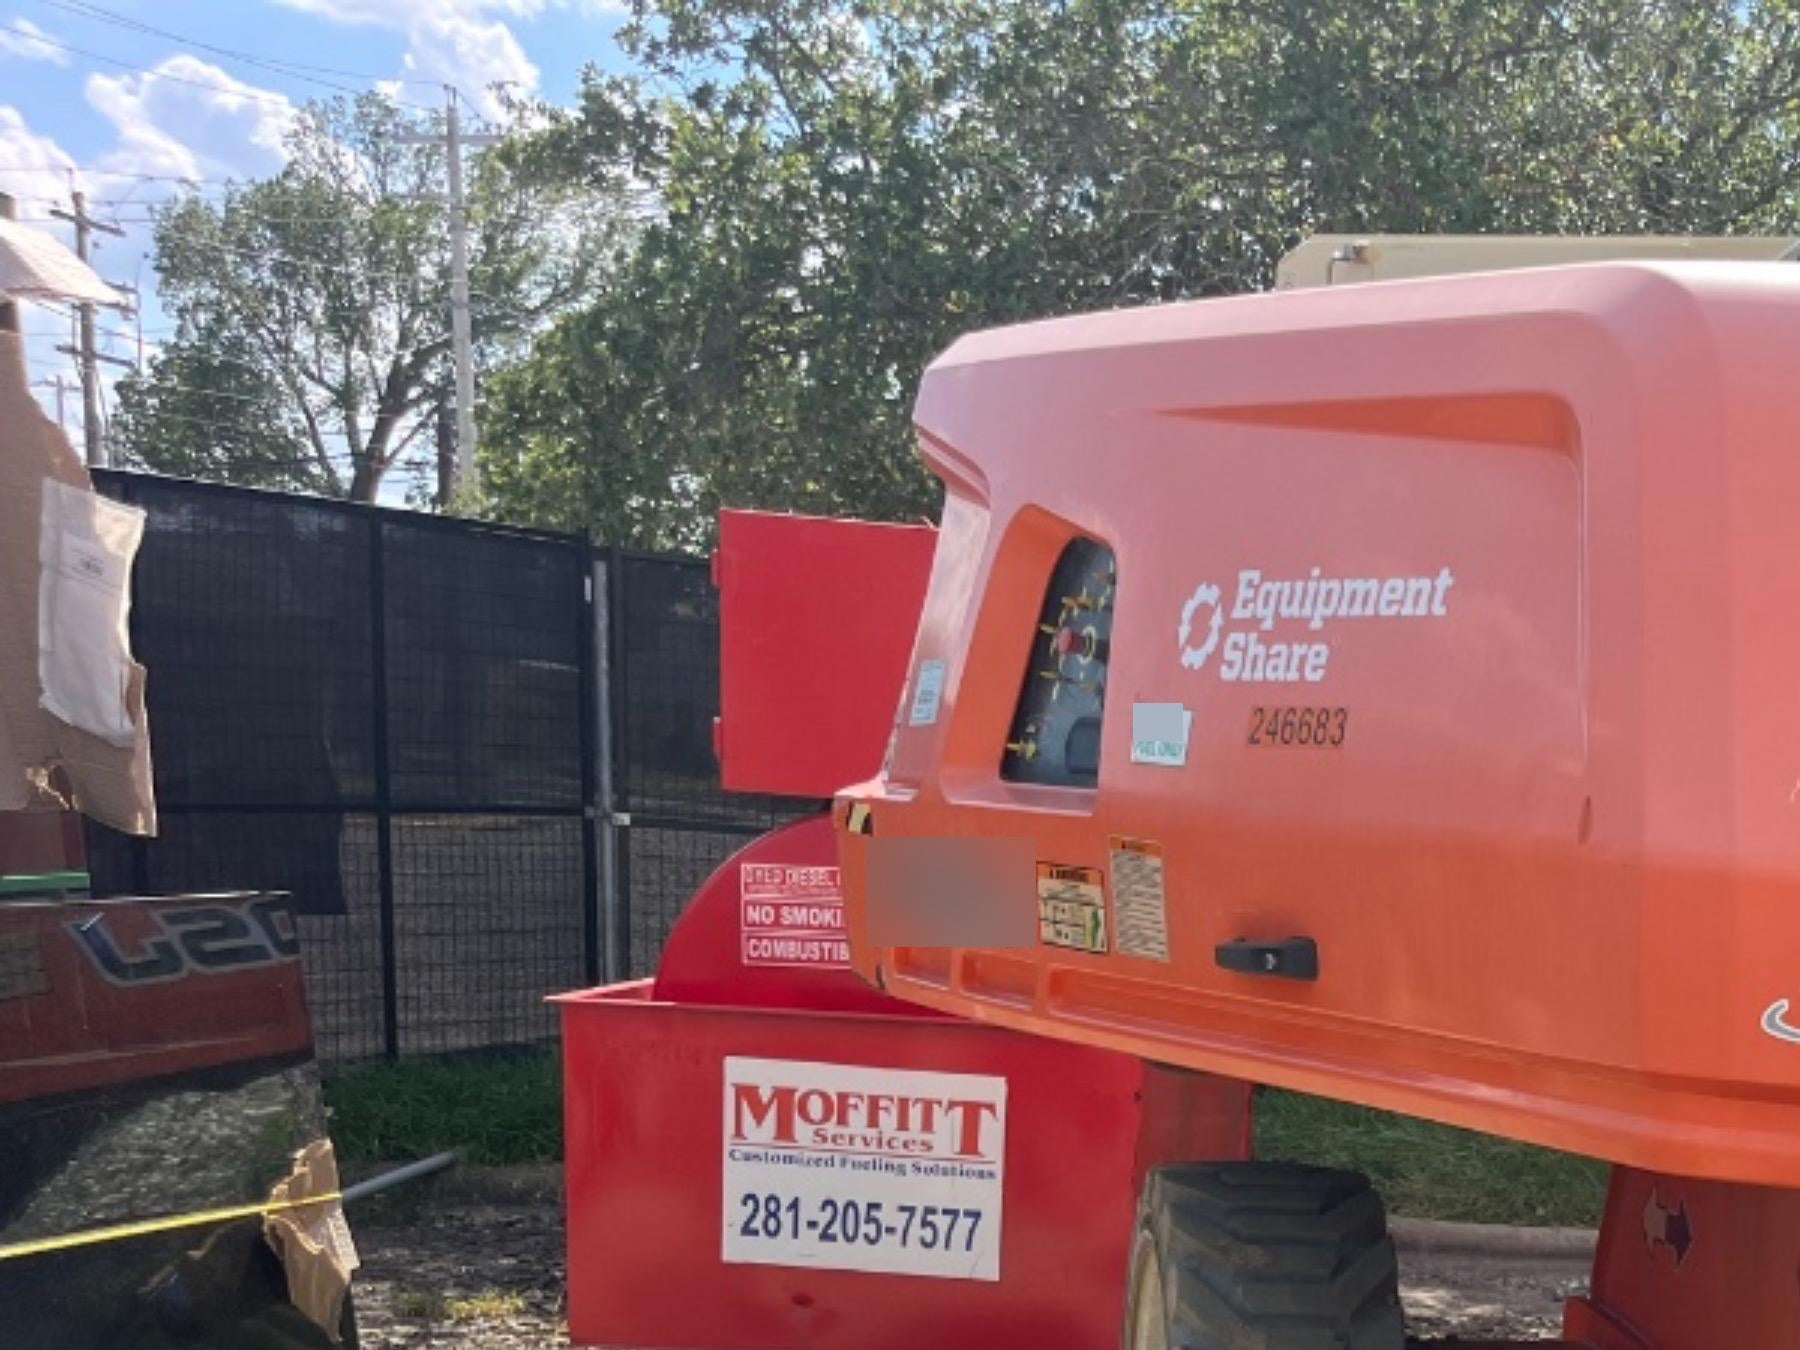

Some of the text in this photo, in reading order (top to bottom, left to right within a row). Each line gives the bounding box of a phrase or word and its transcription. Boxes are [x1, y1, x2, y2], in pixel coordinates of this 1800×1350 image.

[1230, 566, 1454, 631] Equipment
[1220, 631, 1330, 682] Share
[1248, 706, 1348, 747] 246683
[745, 904, 843, 928] NO SMOKI
[748, 937, 850, 962] COMBUSTIB
[730, 1082, 999, 1158] MOFFITT
[812, 1128, 935, 1154] Services
[728, 1148, 997, 1181] Customized Fueling Solutions
[739, 1192, 983, 1252] 281-205-7577
